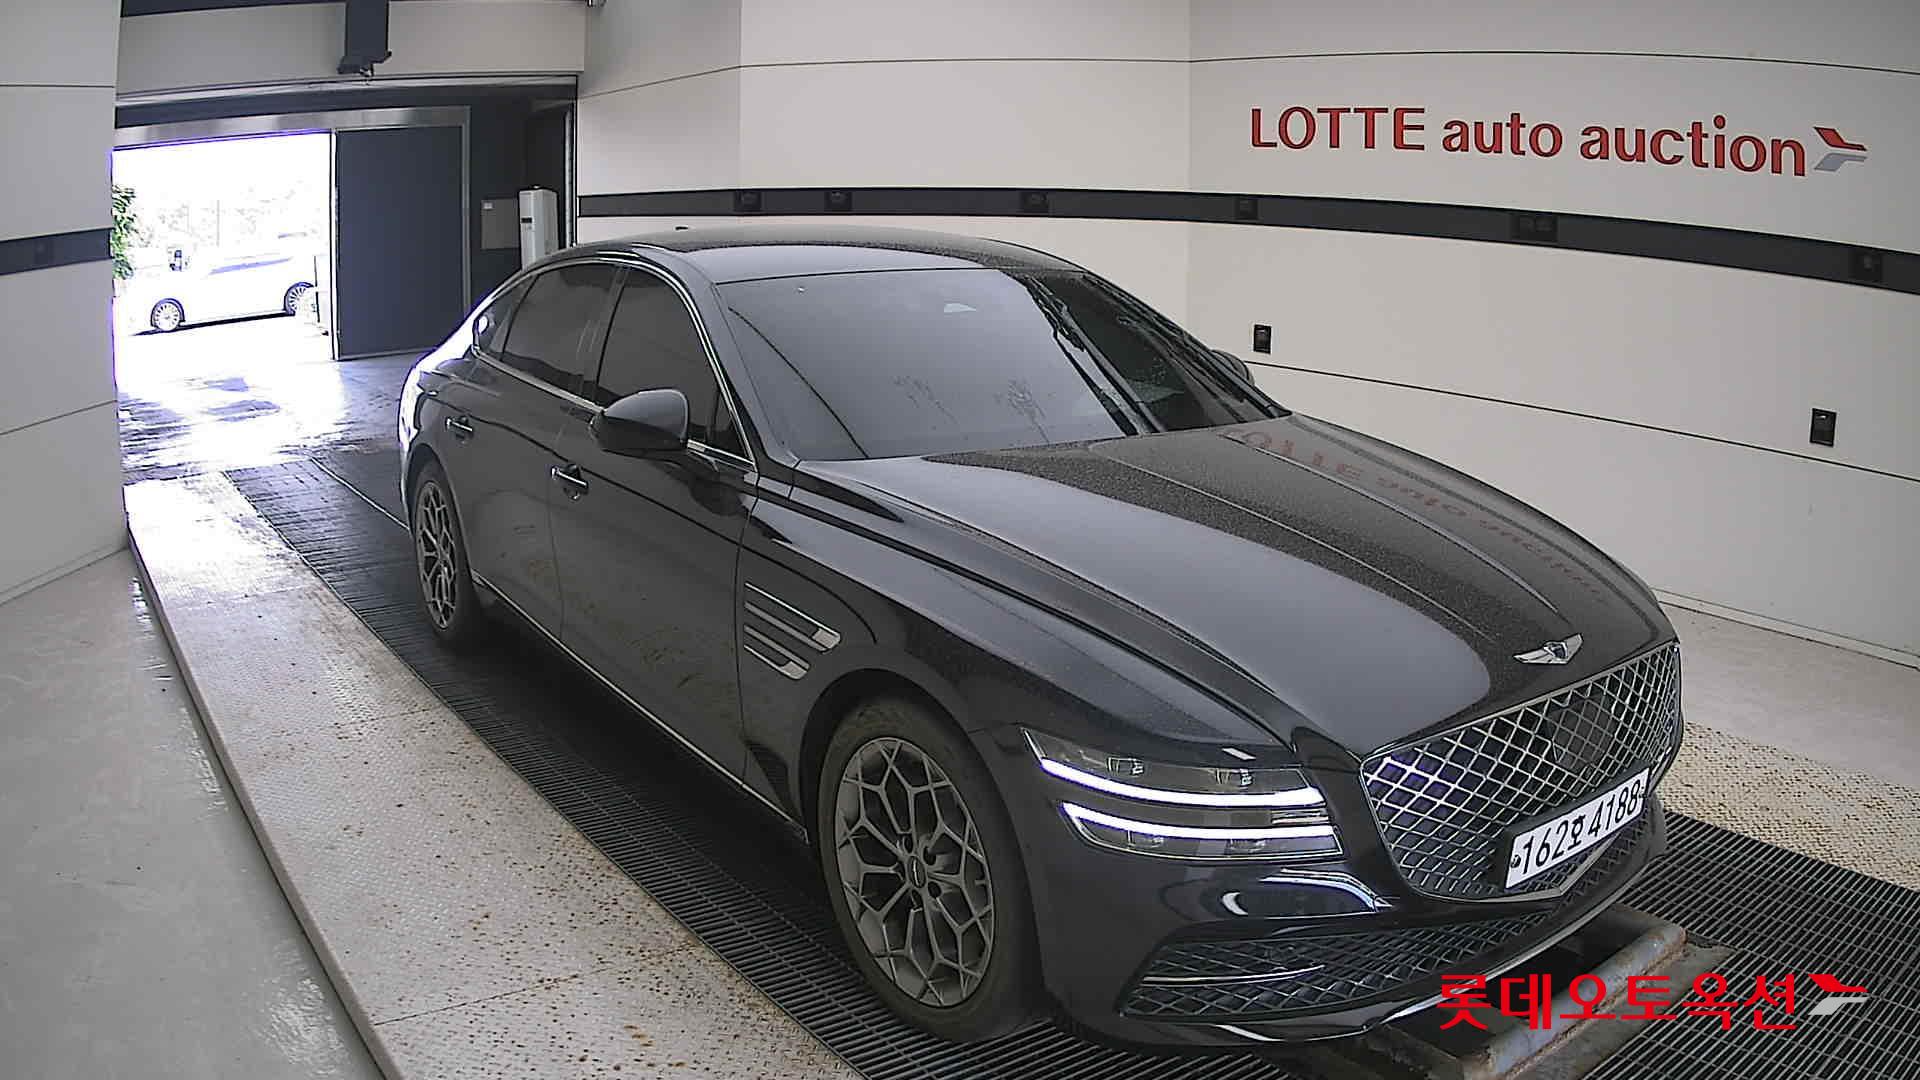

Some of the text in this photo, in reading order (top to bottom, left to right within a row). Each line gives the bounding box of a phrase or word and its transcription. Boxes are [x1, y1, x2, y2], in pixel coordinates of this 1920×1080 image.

[1250, 106, 1806, 177] LOTTE auto auction
[1587, 779, 1642, 838] 4188
